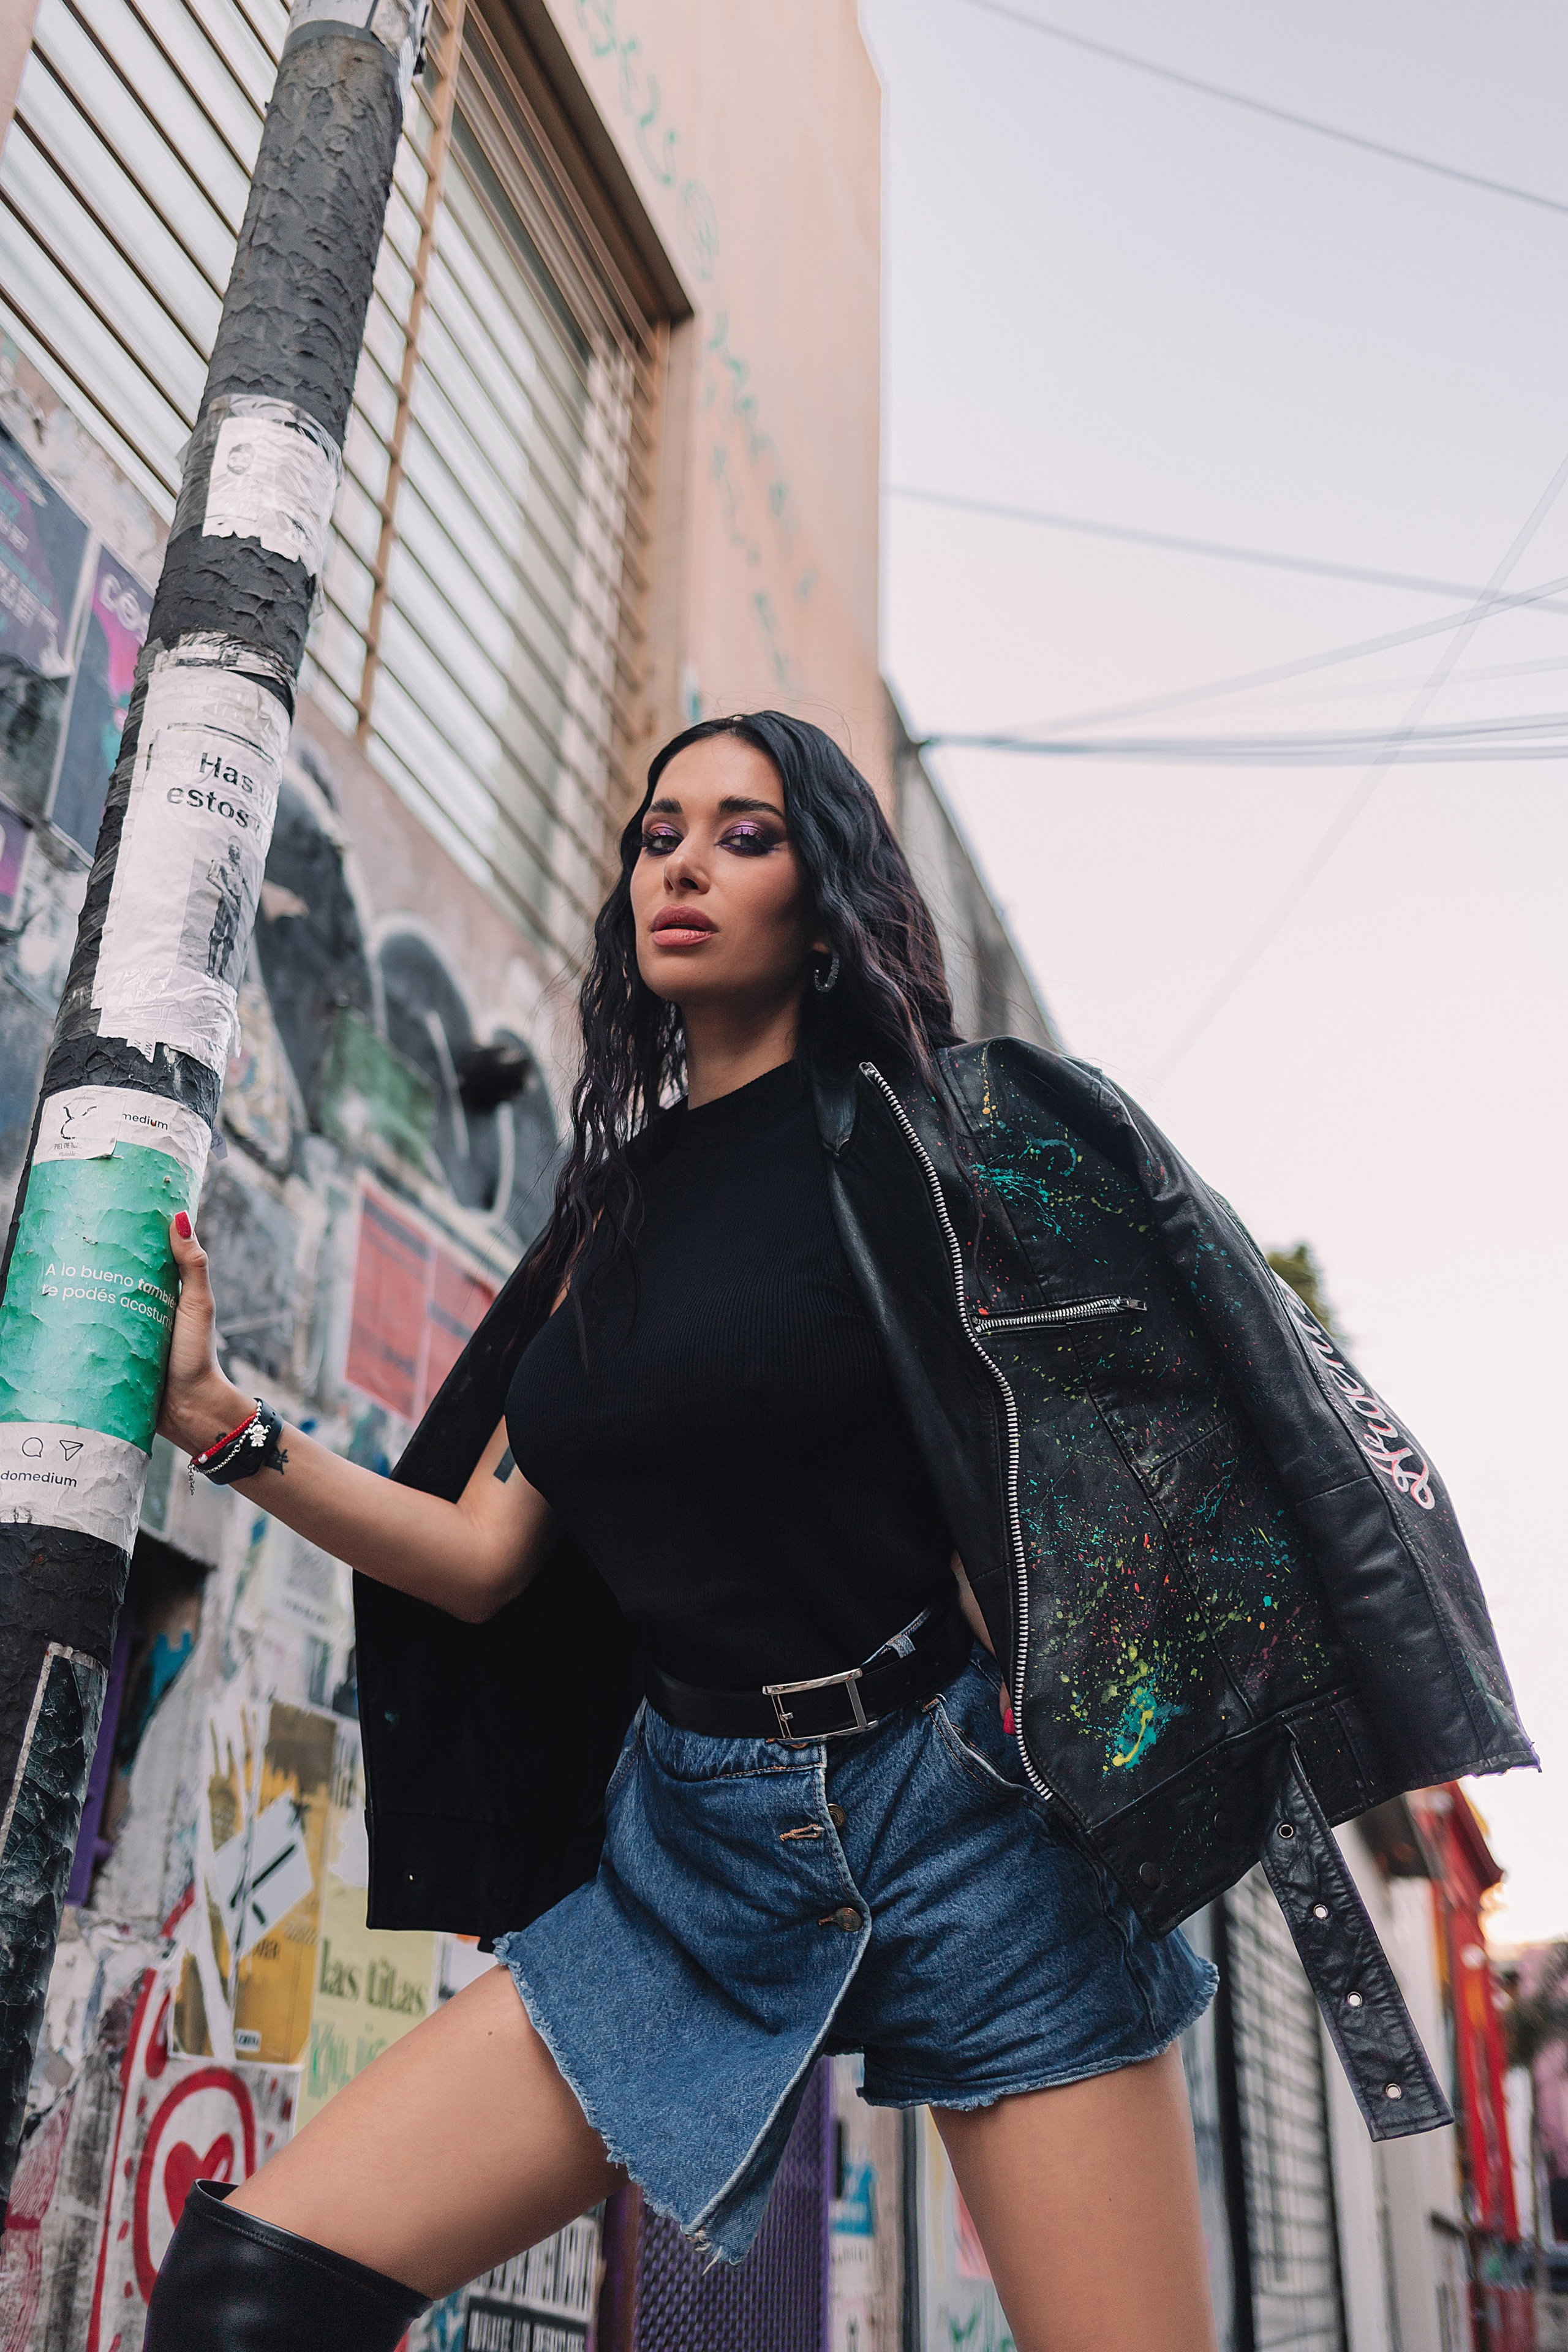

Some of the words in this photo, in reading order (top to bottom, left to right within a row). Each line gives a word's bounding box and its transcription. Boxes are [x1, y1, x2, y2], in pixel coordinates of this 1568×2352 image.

[200, 752, 253, 794] Has
[167, 787, 249, 829] estos
[123, 1113, 168, 1131] medium
[45, 1263, 56, 1276] A
[61, 1263, 76, 1277] lo
[81, 1265, 134, 1287] bueno
[42, 1284, 58, 1297] te
[62, 1287, 116, 1304] podés
[1, 1470, 77, 1488] domedium
[320, 1937, 363, 2003] las
